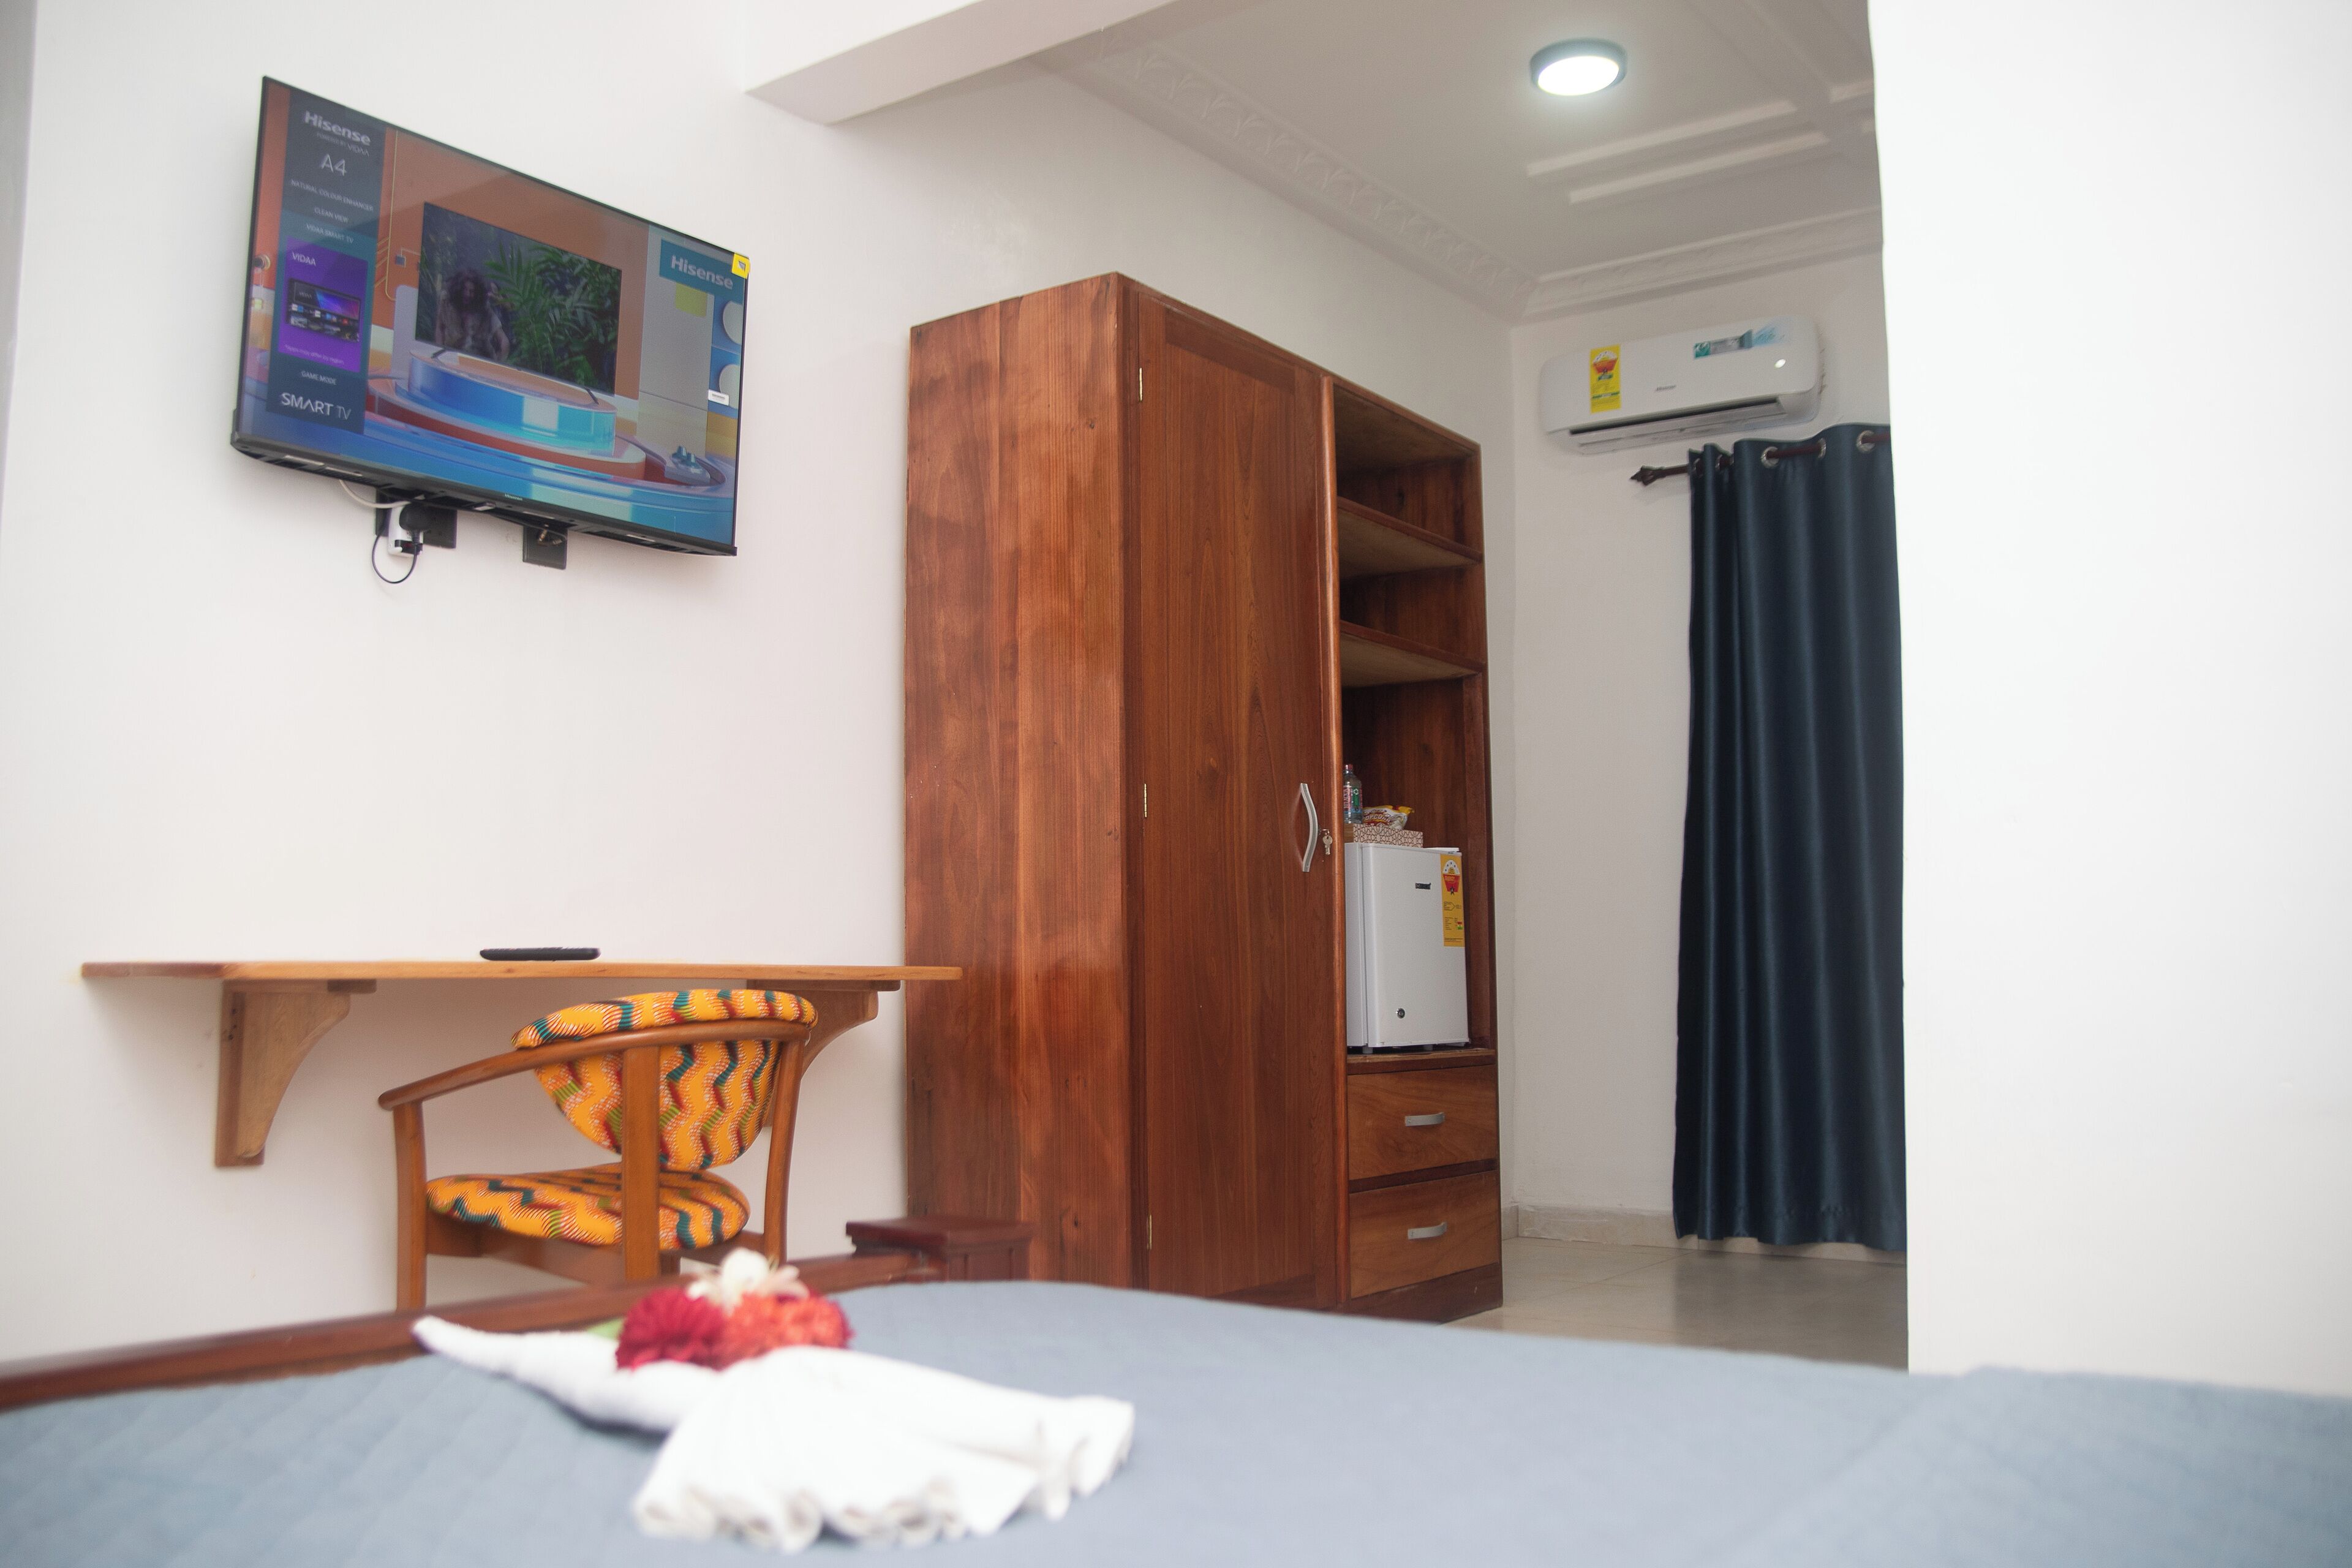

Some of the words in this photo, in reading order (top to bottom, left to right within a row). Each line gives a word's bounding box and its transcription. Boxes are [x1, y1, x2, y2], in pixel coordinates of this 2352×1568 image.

[304, 110, 371, 146] Hisense
[320, 154, 347, 176] A4
[291, 179, 317, 194] NATURAL
[314, 206, 334, 219] CLEAN
[334, 213, 349, 224] VIEW
[324, 229, 345, 241] SMART
[345, 235, 354, 244] TV
[292, 251, 316, 266] VIDAA
[671, 254, 733, 290] Hisense
[301, 371, 318, 381] GAME
[319, 375, 337, 385] MODE
[281, 392, 334, 416] SMART
[337, 405, 352, 420] TV
